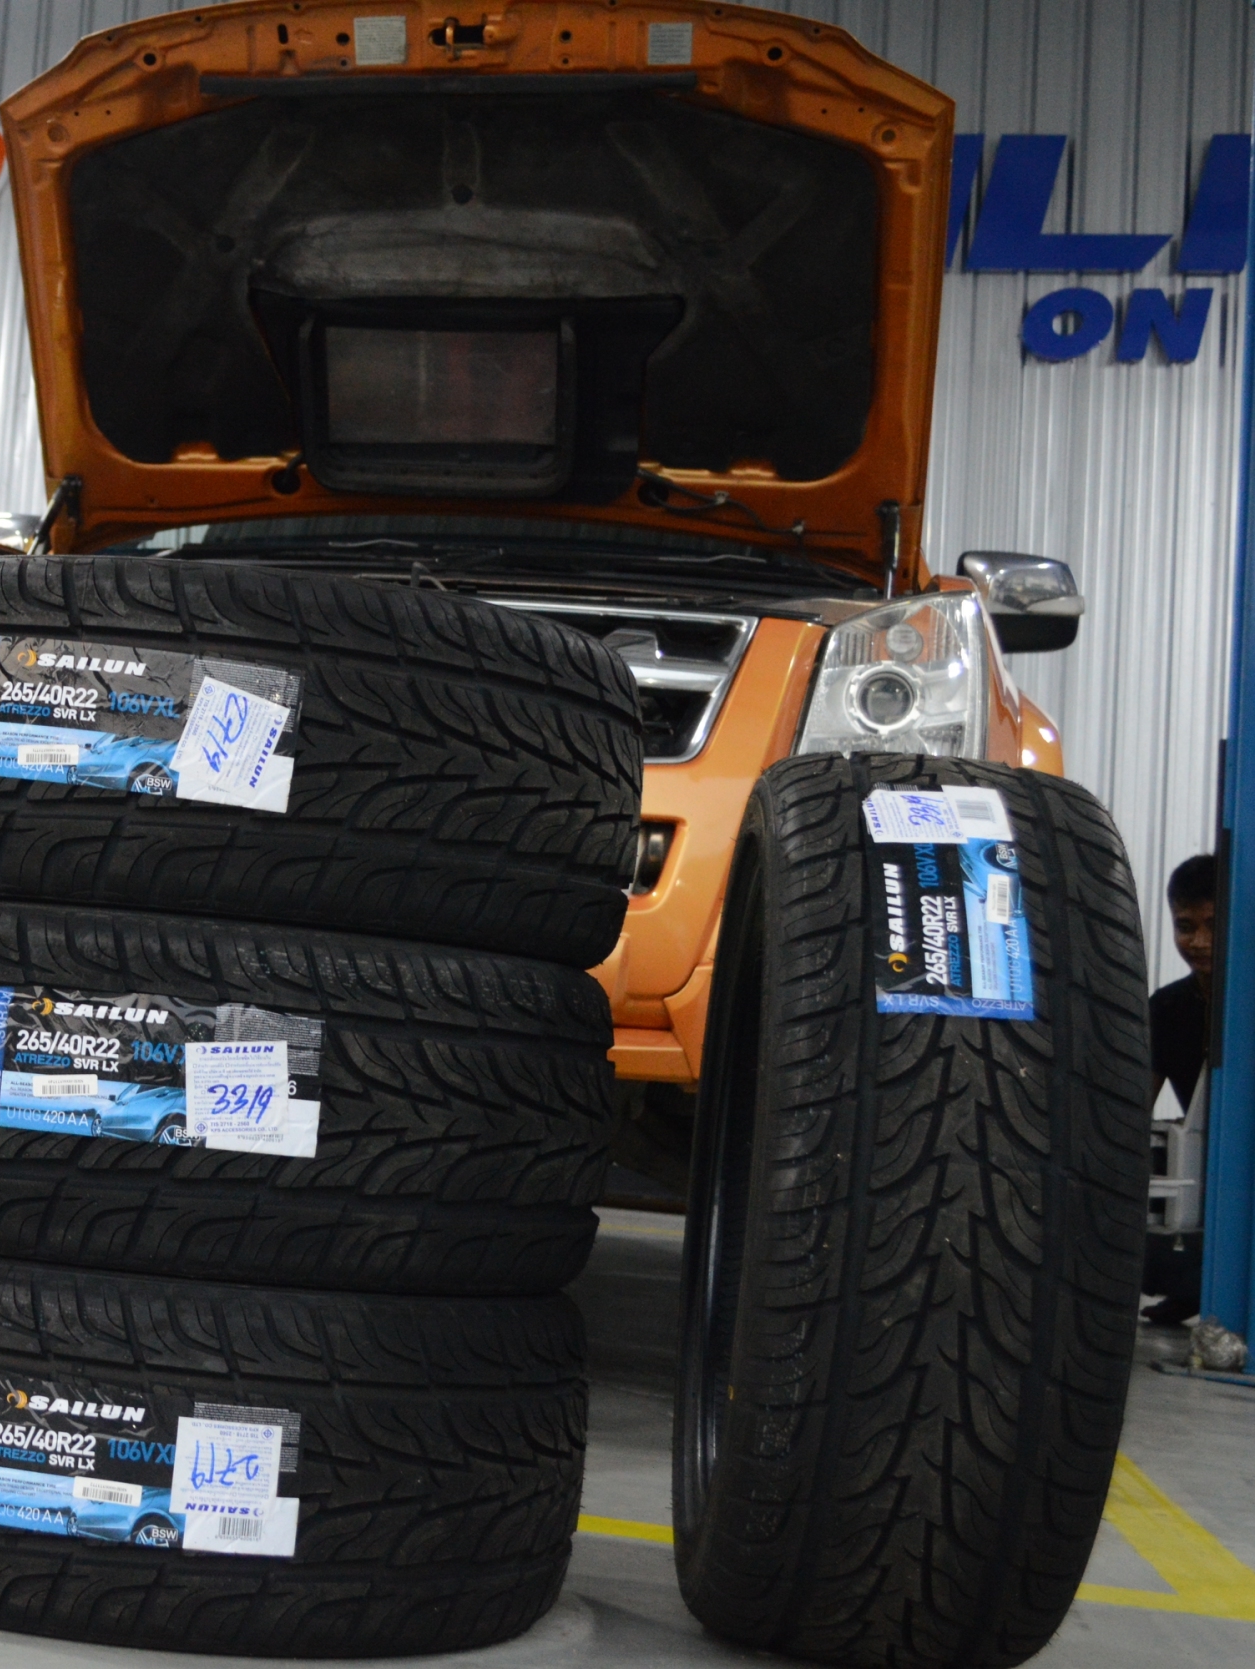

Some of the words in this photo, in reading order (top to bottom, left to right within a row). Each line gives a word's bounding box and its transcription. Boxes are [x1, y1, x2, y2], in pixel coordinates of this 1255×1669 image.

[37, 652, 147, 676] SAILUN
[0, 680, 99, 709] 265/40R22
[53, 707, 78, 720] SVR
[79, 710, 97, 722] LX
[248, 727, 278, 789] SAILUN
[146, 777, 172, 789] BSW
[883, 862, 905, 953] SAILUN
[944, 896, 957, 910] LX
[946, 910, 958, 933] SVR
[920, 895, 948, 985] 265/40R22
[1006, 939, 1020, 959] 420
[947, 933, 963, 987] ATREZZO
[883, 994, 903, 1007] LX
[908, 994, 940, 1007] SVR
[971, 999, 1026, 1011] ATREZZO
[53, 1002, 169, 1025] SAILUN
[16, 1029, 121, 1059] 265/40R22
[210, 1045, 274, 1054] SAILUN
[13, 1052, 71, 1067] ATREZZO
[73, 1057, 99, 1071] SVR
[102, 1059, 119, 1072] LX
[6, 1107, 41, 1122] UTQG
[43, 1109, 65, 1124] 420
[66, 1112, 77, 1126] A
[78, 1113, 89, 1127] A
[28, 1394, 146, 1423] SAILUN
[48, 1454, 76, 1468] SVR
[77, 1457, 95, 1470] LX
[17, 1506, 41, 1521] 420
[42, 1509, 53, 1524] A
[53, 1511, 64, 1525] A
[185, 1502, 251, 1515] SAILUN
[151, 1528, 178, 1540] BSW
